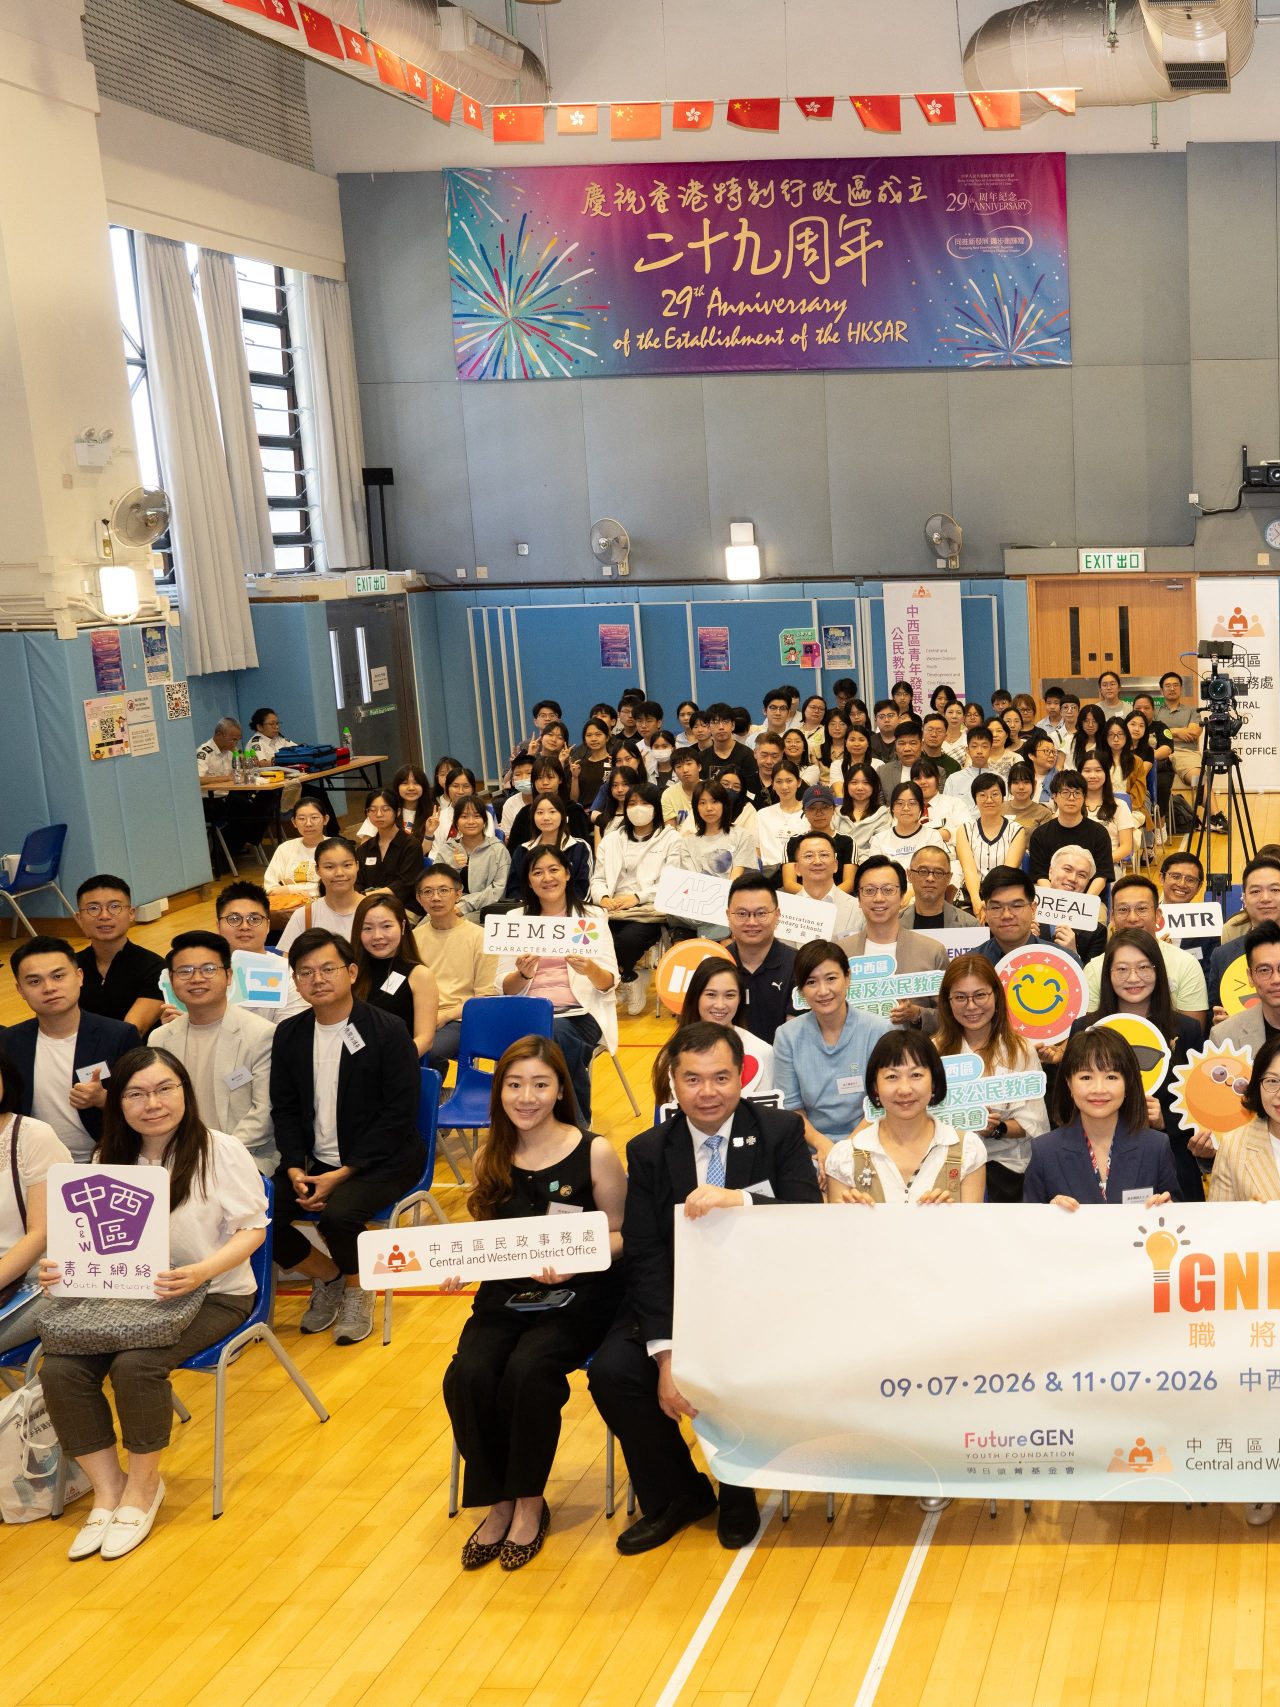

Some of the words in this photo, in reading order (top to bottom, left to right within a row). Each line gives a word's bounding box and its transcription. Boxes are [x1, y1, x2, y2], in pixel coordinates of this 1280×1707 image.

[581, 174, 928, 217] 慶祝香港特別行政區成立
[973, 201, 1028, 211] ANNIVERSARY
[634, 213, 884, 287] 二十九周年
[661, 284, 705, 319] 29th
[706, 286, 848, 323] Anniversary
[612, 327, 630, 358] of
[636, 327, 661, 351] the
[664, 325, 784, 350] Establishment
[789, 322, 809, 352] of
[815, 322, 841, 349] the
[847, 319, 909, 345] HKSAR
[1085, 554, 1113, 569] EXIT
[1117, 554, 1139, 568] 出口
[356, 576, 372, 592] EXIT
[373, 575, 386, 591] 出口
[1236, 701, 1261, 709] TRAL
[1245, 747, 1278, 756] OFFICE
[781, 913, 814, 925] ssociation
[1037, 910, 1074, 922] ROUPE
[1167, 912, 1216, 929] MTR
[490, 922, 566, 940] JEMS
[488, 945, 548, 953] CHARACTER
[551, 947, 599, 955] ACADEMY
[851, 959, 888, 975] 中西區
[429, 1229, 596, 1255] 中西區民政事務處
[429, 1255, 465, 1268] Central
[466, 1254, 486, 1265] and
[487, 1250, 528, 1264] Western
[530, 1247, 564, 1261] District
[567, 1245, 598, 1257] Office
[64, 1260, 152, 1277] 青年網絡
[63, 1279, 98, 1289] Youth
[103, 1280, 151, 1290] Network
[1045, 1371, 1063, 1393] &
[964, 1428, 1074, 1449] FutureGEN
[1005, 1451, 1075, 1459] FOUNDATION
[1185, 1457, 1234, 1472] Central
[1236, 1457, 1263, 1471] and
